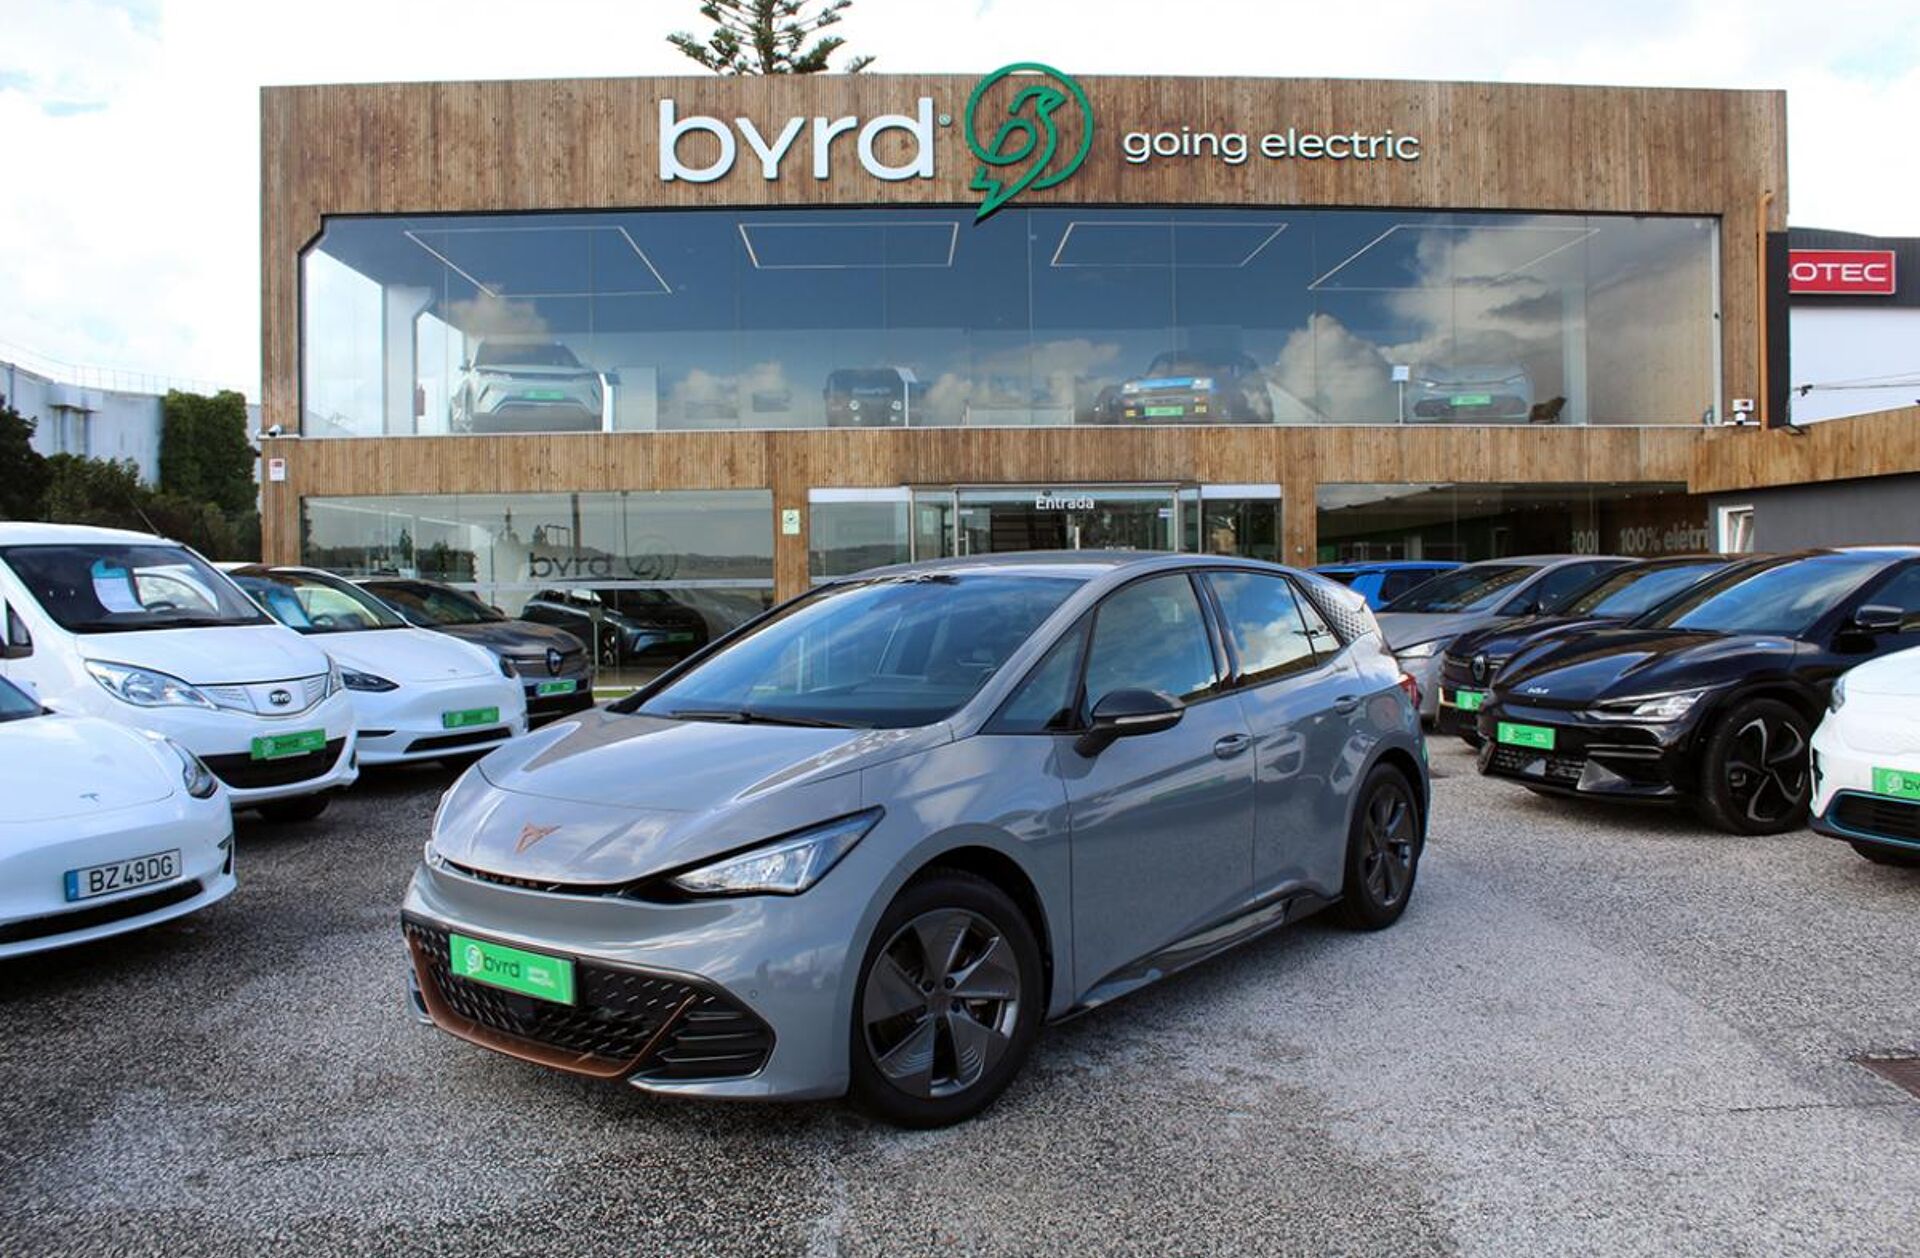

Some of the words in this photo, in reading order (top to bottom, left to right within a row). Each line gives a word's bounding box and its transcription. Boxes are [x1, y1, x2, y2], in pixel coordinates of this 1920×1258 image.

[659, 96, 934, 182] byrd
[1123, 126, 1248, 164] going
[1260, 127, 1420, 160] electric
[1788, 262, 1887, 282] OTEC
[1036, 495, 1094, 510] Entrada
[1619, 526, 1662, 553] 100%
[529, 552, 613, 578] byrd
[483, 955, 520, 978] byrd
